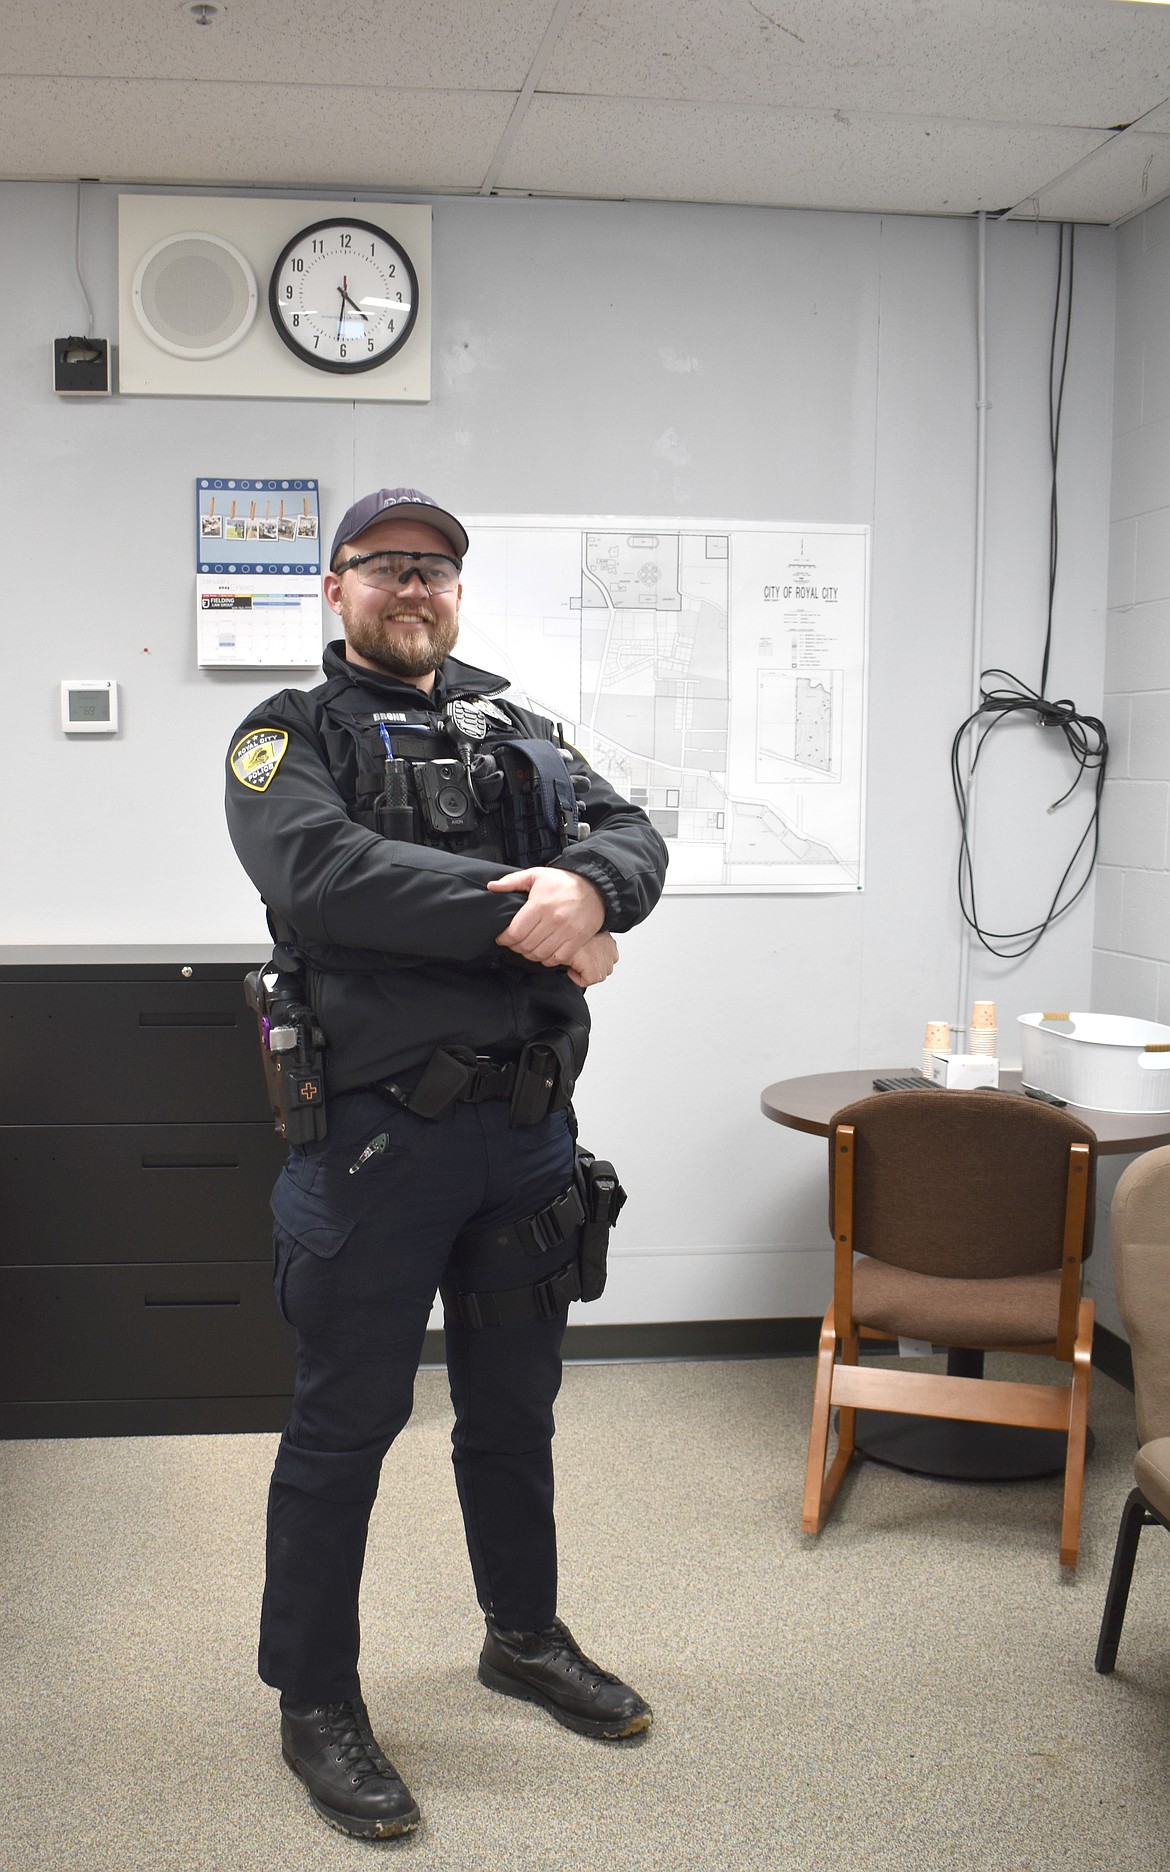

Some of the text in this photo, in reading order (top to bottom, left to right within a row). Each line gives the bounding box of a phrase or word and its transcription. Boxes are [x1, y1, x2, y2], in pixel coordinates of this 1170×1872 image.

[312, 239, 324, 253] 11
[340, 234, 352, 248] 12
[370, 243, 375, 257] 1
[291, 258, 304, 272] 10
[388, 264, 396, 278] 2
[286, 285, 293, 299] 9
[395, 291, 403, 304] 3
[292, 313, 300, 327] 8
[387, 319, 395, 332] 4
[313, 335, 320, 349] 7
[367, 338, 374, 352] 5
[339, 343, 347, 358] 6
[764, 586, 838, 599] CITY OF ROYAL CITY
[238, 734, 278, 757] ROYAL CITY
[248, 763, 274, 782] POLICE
